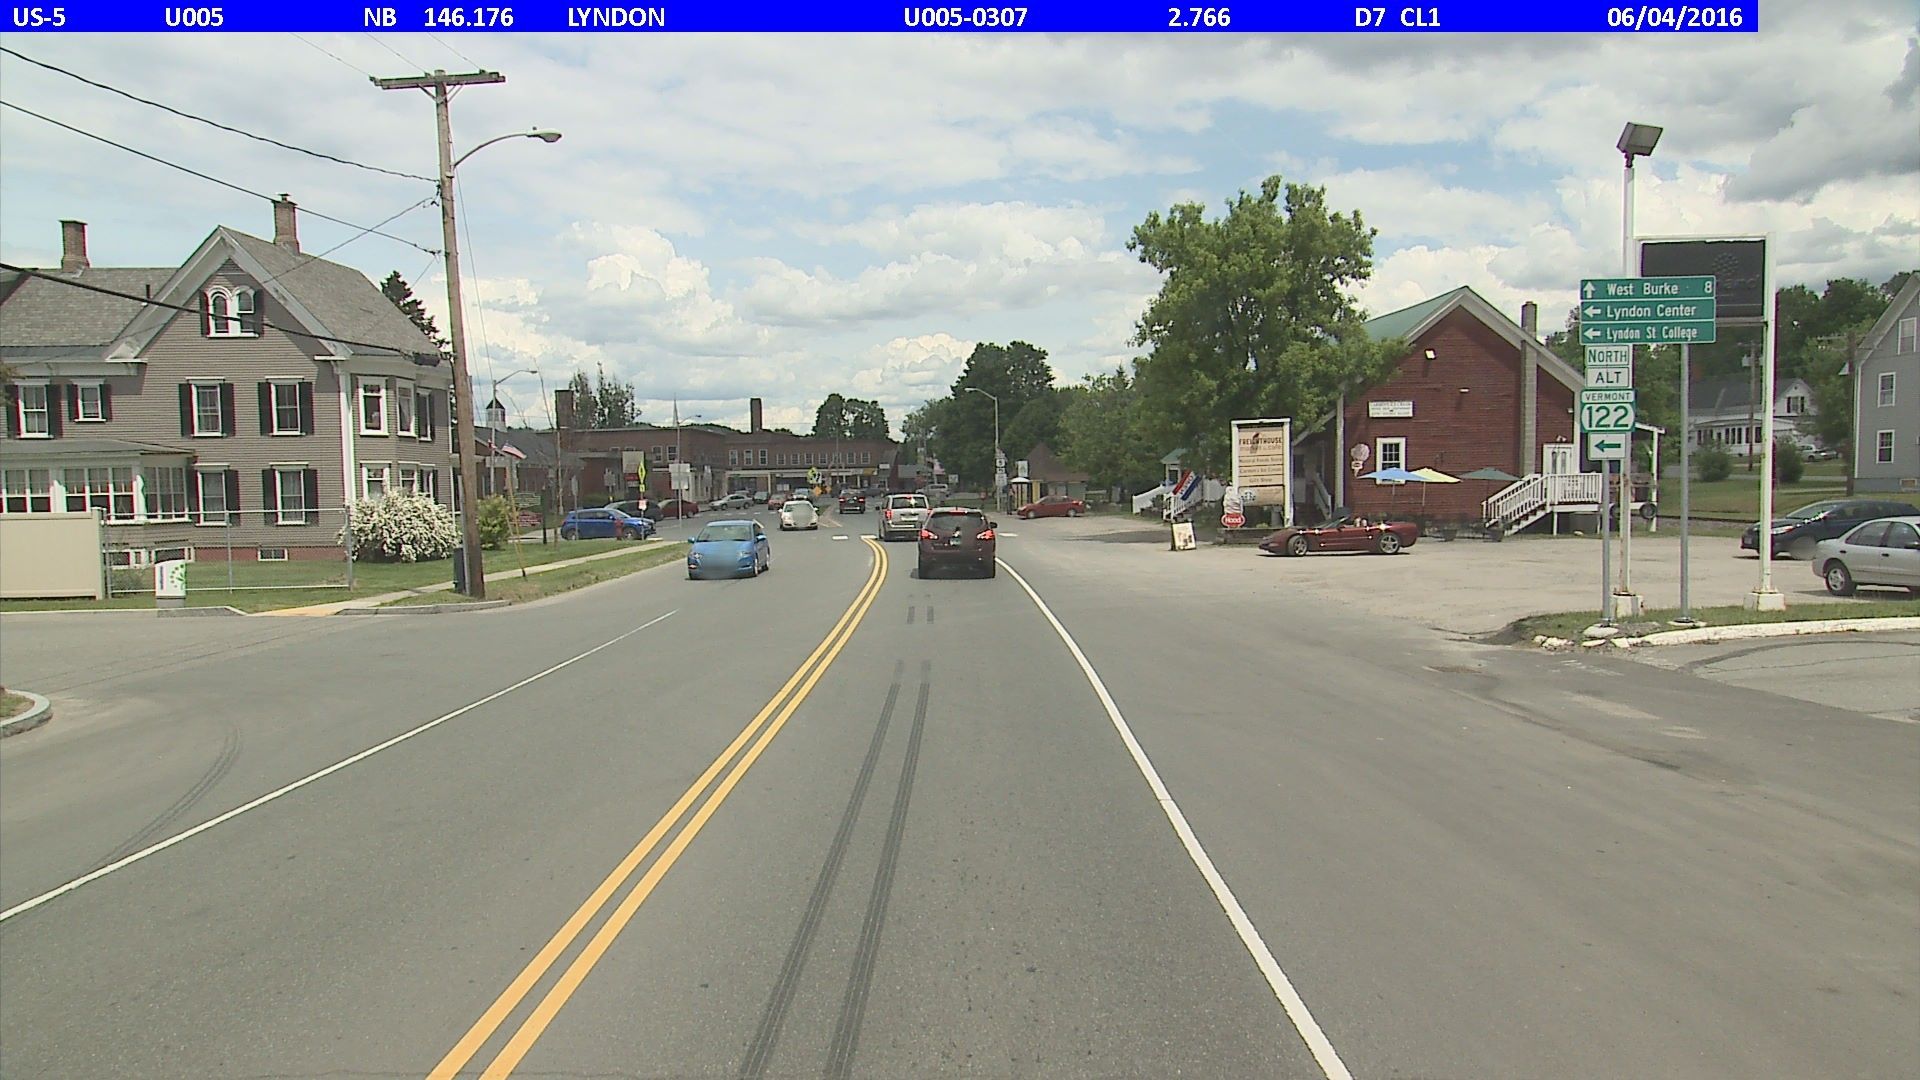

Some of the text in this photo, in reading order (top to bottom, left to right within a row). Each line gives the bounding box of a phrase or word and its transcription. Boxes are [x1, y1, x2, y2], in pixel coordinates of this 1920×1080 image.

[1607, 283, 1634, 296] West
[1643, 282, 1679, 295] Burke
[1704, 281, 1712, 294] 8
[1607, 304, 1697, 320] Lyndon Center
[1607, 326, 1697, 342] Lyndon St College
[1588, 349, 1627, 363] NORTH
[1595, 371, 1622, 384] ALT
[1585, 392, 1631, 401] VERMONT
[1586, 405, 1629, 428] 122
[1225, 516, 1242, 524] Hood
